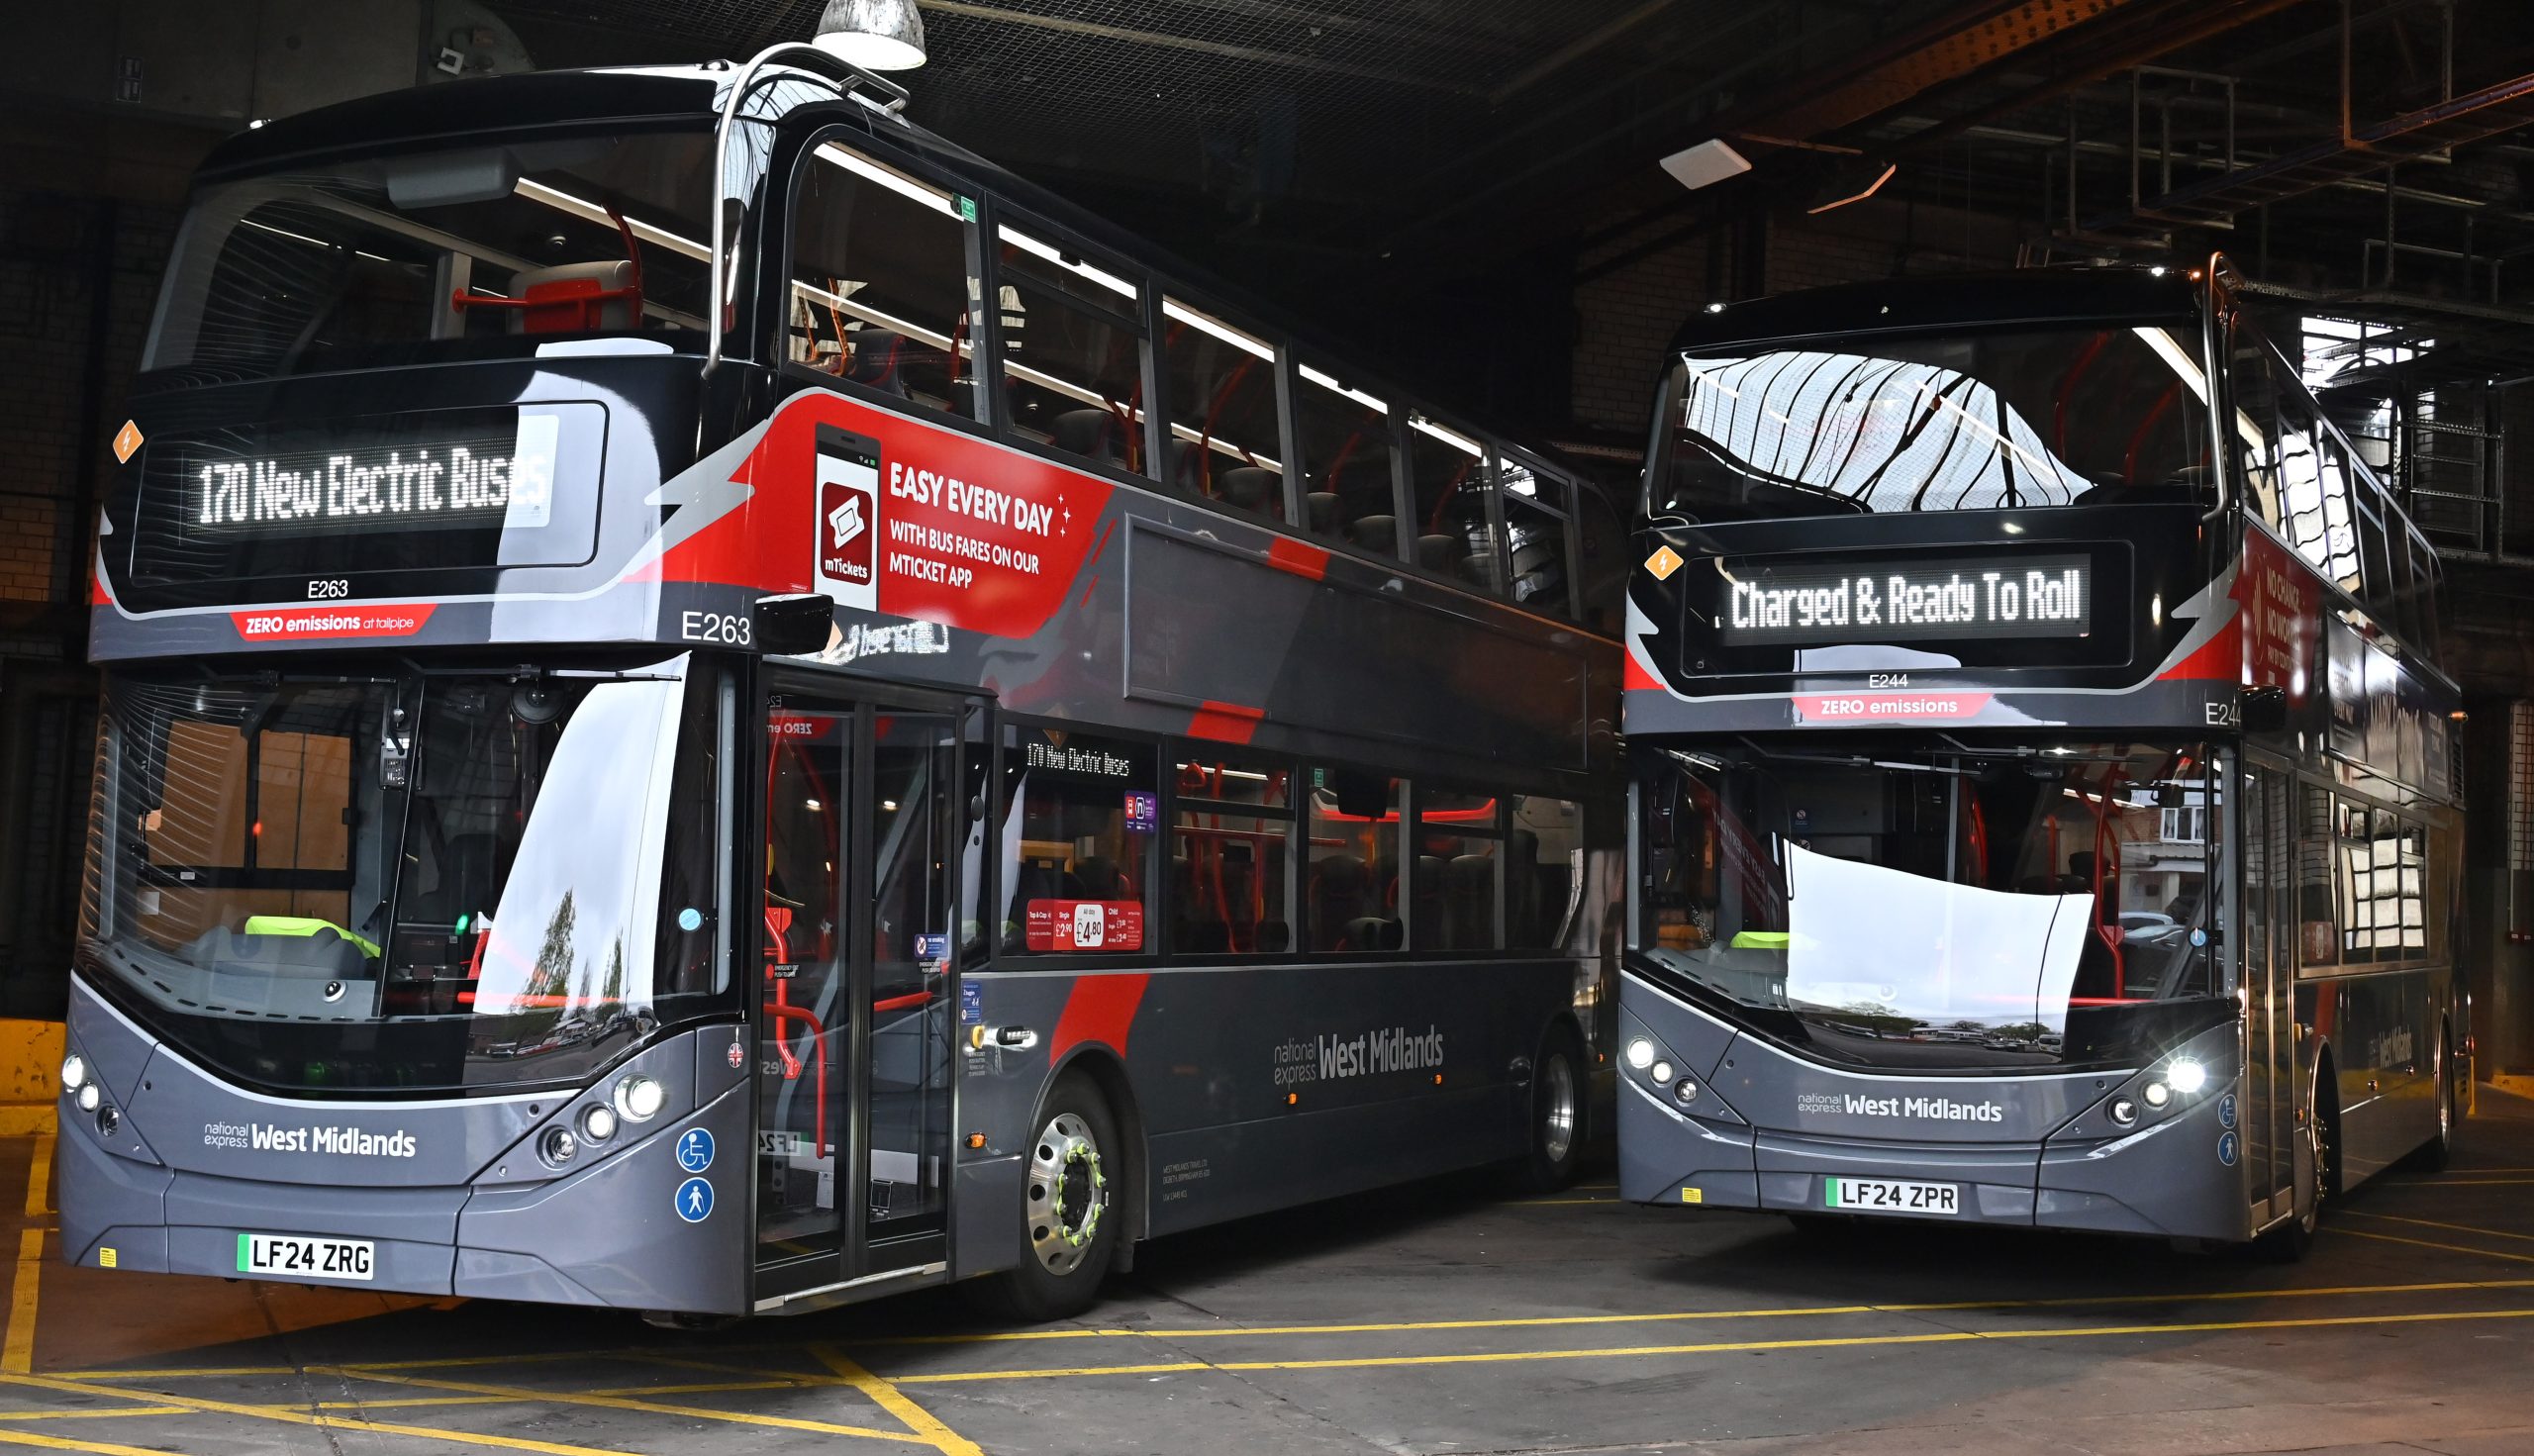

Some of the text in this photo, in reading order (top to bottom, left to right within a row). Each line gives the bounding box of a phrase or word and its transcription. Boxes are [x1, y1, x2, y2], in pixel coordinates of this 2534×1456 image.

[199, 445, 547, 524] 170 New Electric Buses
[891, 462, 1053, 536] EASY EVERY DAY
[890, 518, 1039, 575] WITH BUS FARES ON OUR
[825, 556, 868, 580] mTickets
[890, 551, 973, 590] MTICKET APP
[308, 579, 348, 599] E263
[1731, 569, 2080, 629] Charged & Ready To Roll
[245, 614, 414, 634] ZERO emissions at tailpipe
[681, 611, 751, 645] E263
[1869, 673, 1909, 689] E244
[1820, 697, 1958, 715] ZERO emissions
[2205, 702, 2241, 727] E244
[1047, 744, 1066, 769] New
[1069, 747, 1102, 773] Electric
[1105, 752, 1129, 776] Buses
[1076, 922, 1101, 943] £4.80
[1274, 1035, 1316, 1065] national
[1318, 1023, 1443, 1080] West Midlands
[1274, 1062, 1316, 1090] express
[1798, 1093, 1842, 1105] national
[1798, 1103, 1842, 1115] express
[1844, 1094, 2002, 1122] West Midlands
[204, 1121, 248, 1137] national
[204, 1134, 248, 1150] express
[251, 1123, 416, 1158] West Midlands
[1842, 1182, 1954, 1210] LF24 ZPR
[253, 1240, 369, 1274] LF24 ZRG
